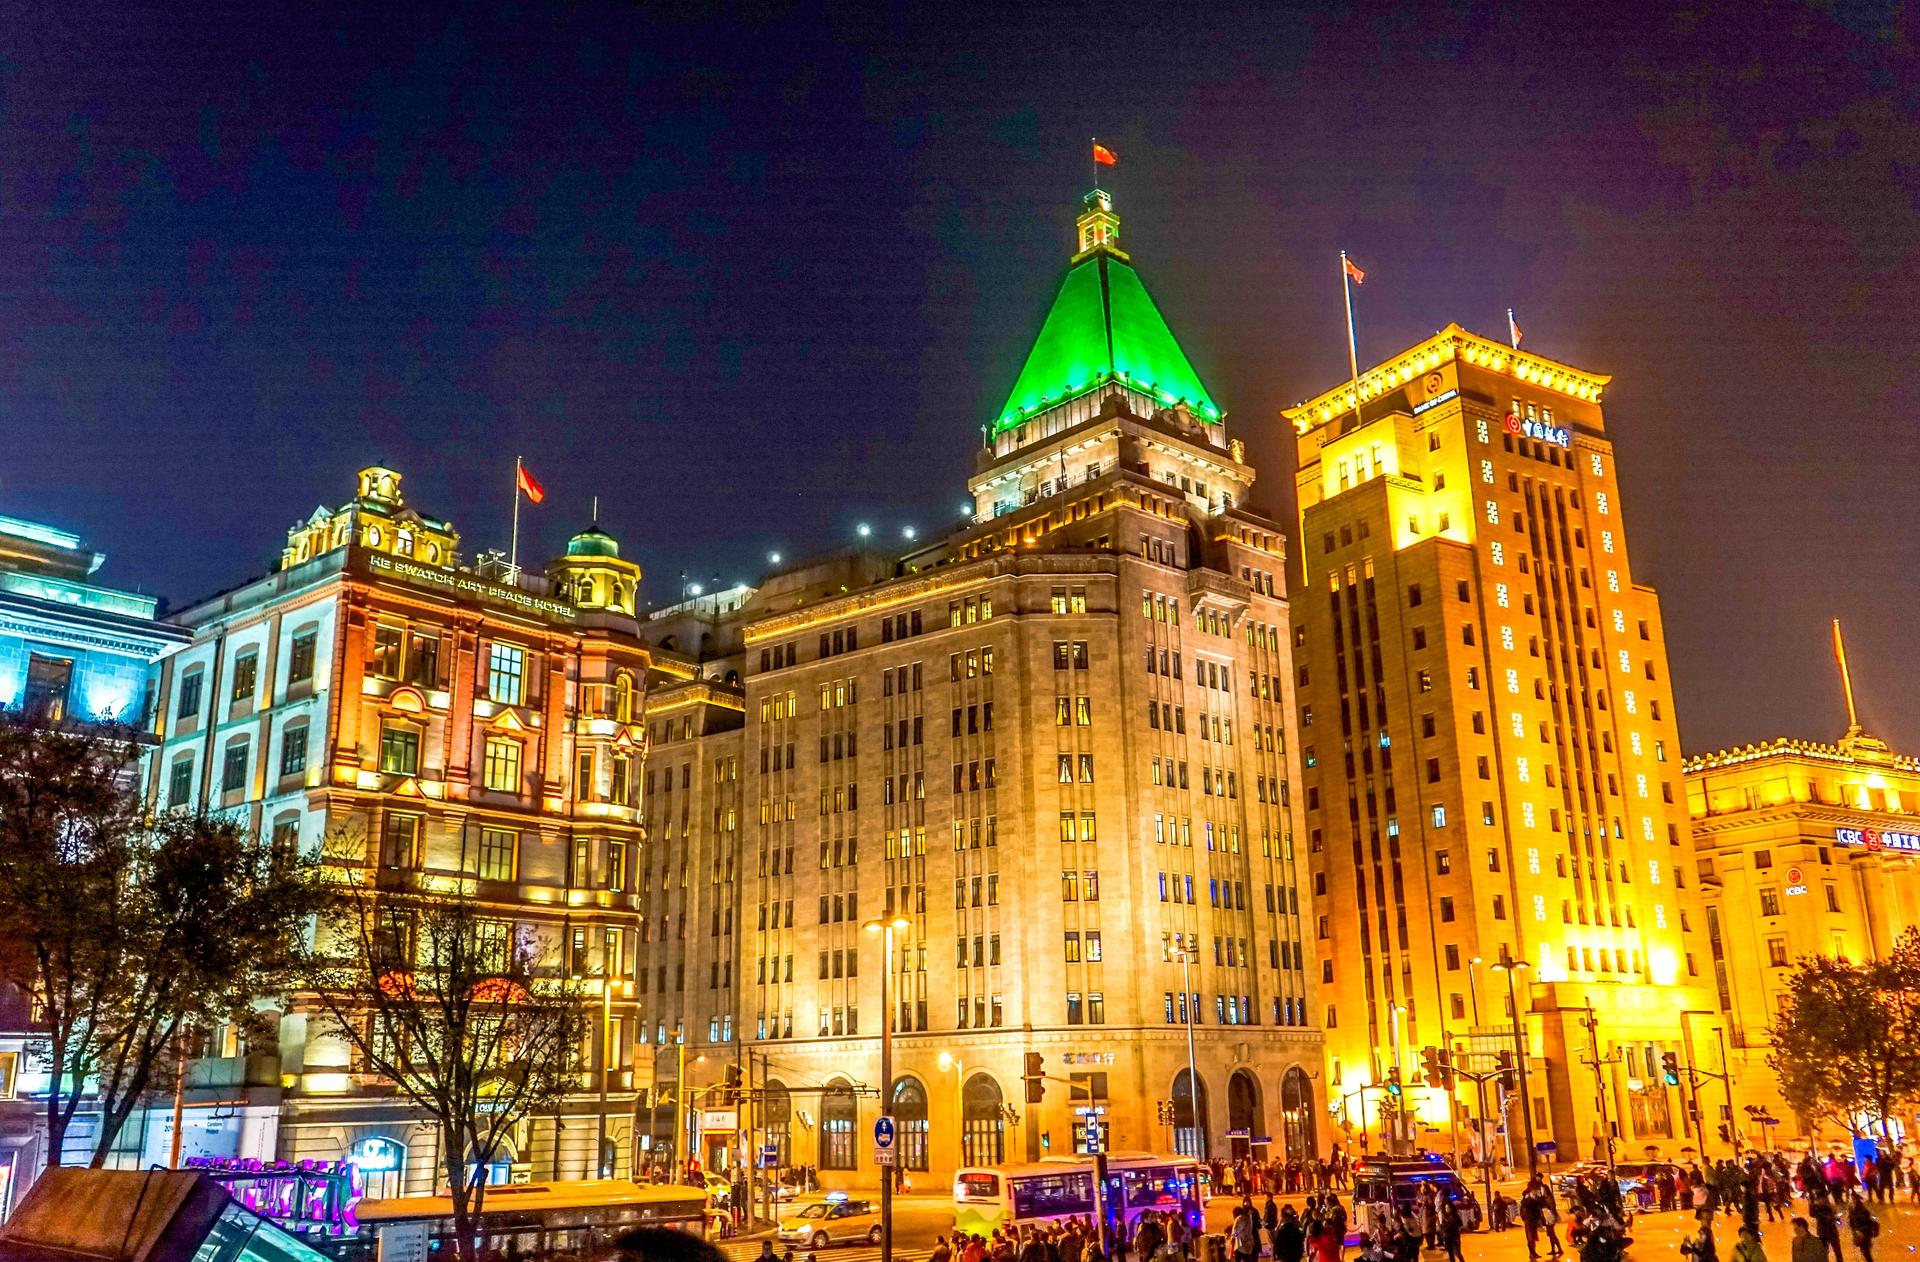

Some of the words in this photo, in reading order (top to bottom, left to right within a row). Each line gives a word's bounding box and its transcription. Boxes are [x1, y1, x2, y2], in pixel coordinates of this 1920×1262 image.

[1522, 418, 1568, 448] 中国银行
[370, 554, 391, 569] HE
[395, 562, 454, 586] SWATCH
[457, 579, 486, 593] ART
[488, 586, 532, 606] PEACE
[534, 598, 576, 618] HOTEL
[1836, 828, 1865, 845] ICBC
[1785, 885, 1808, 896] ICBC
